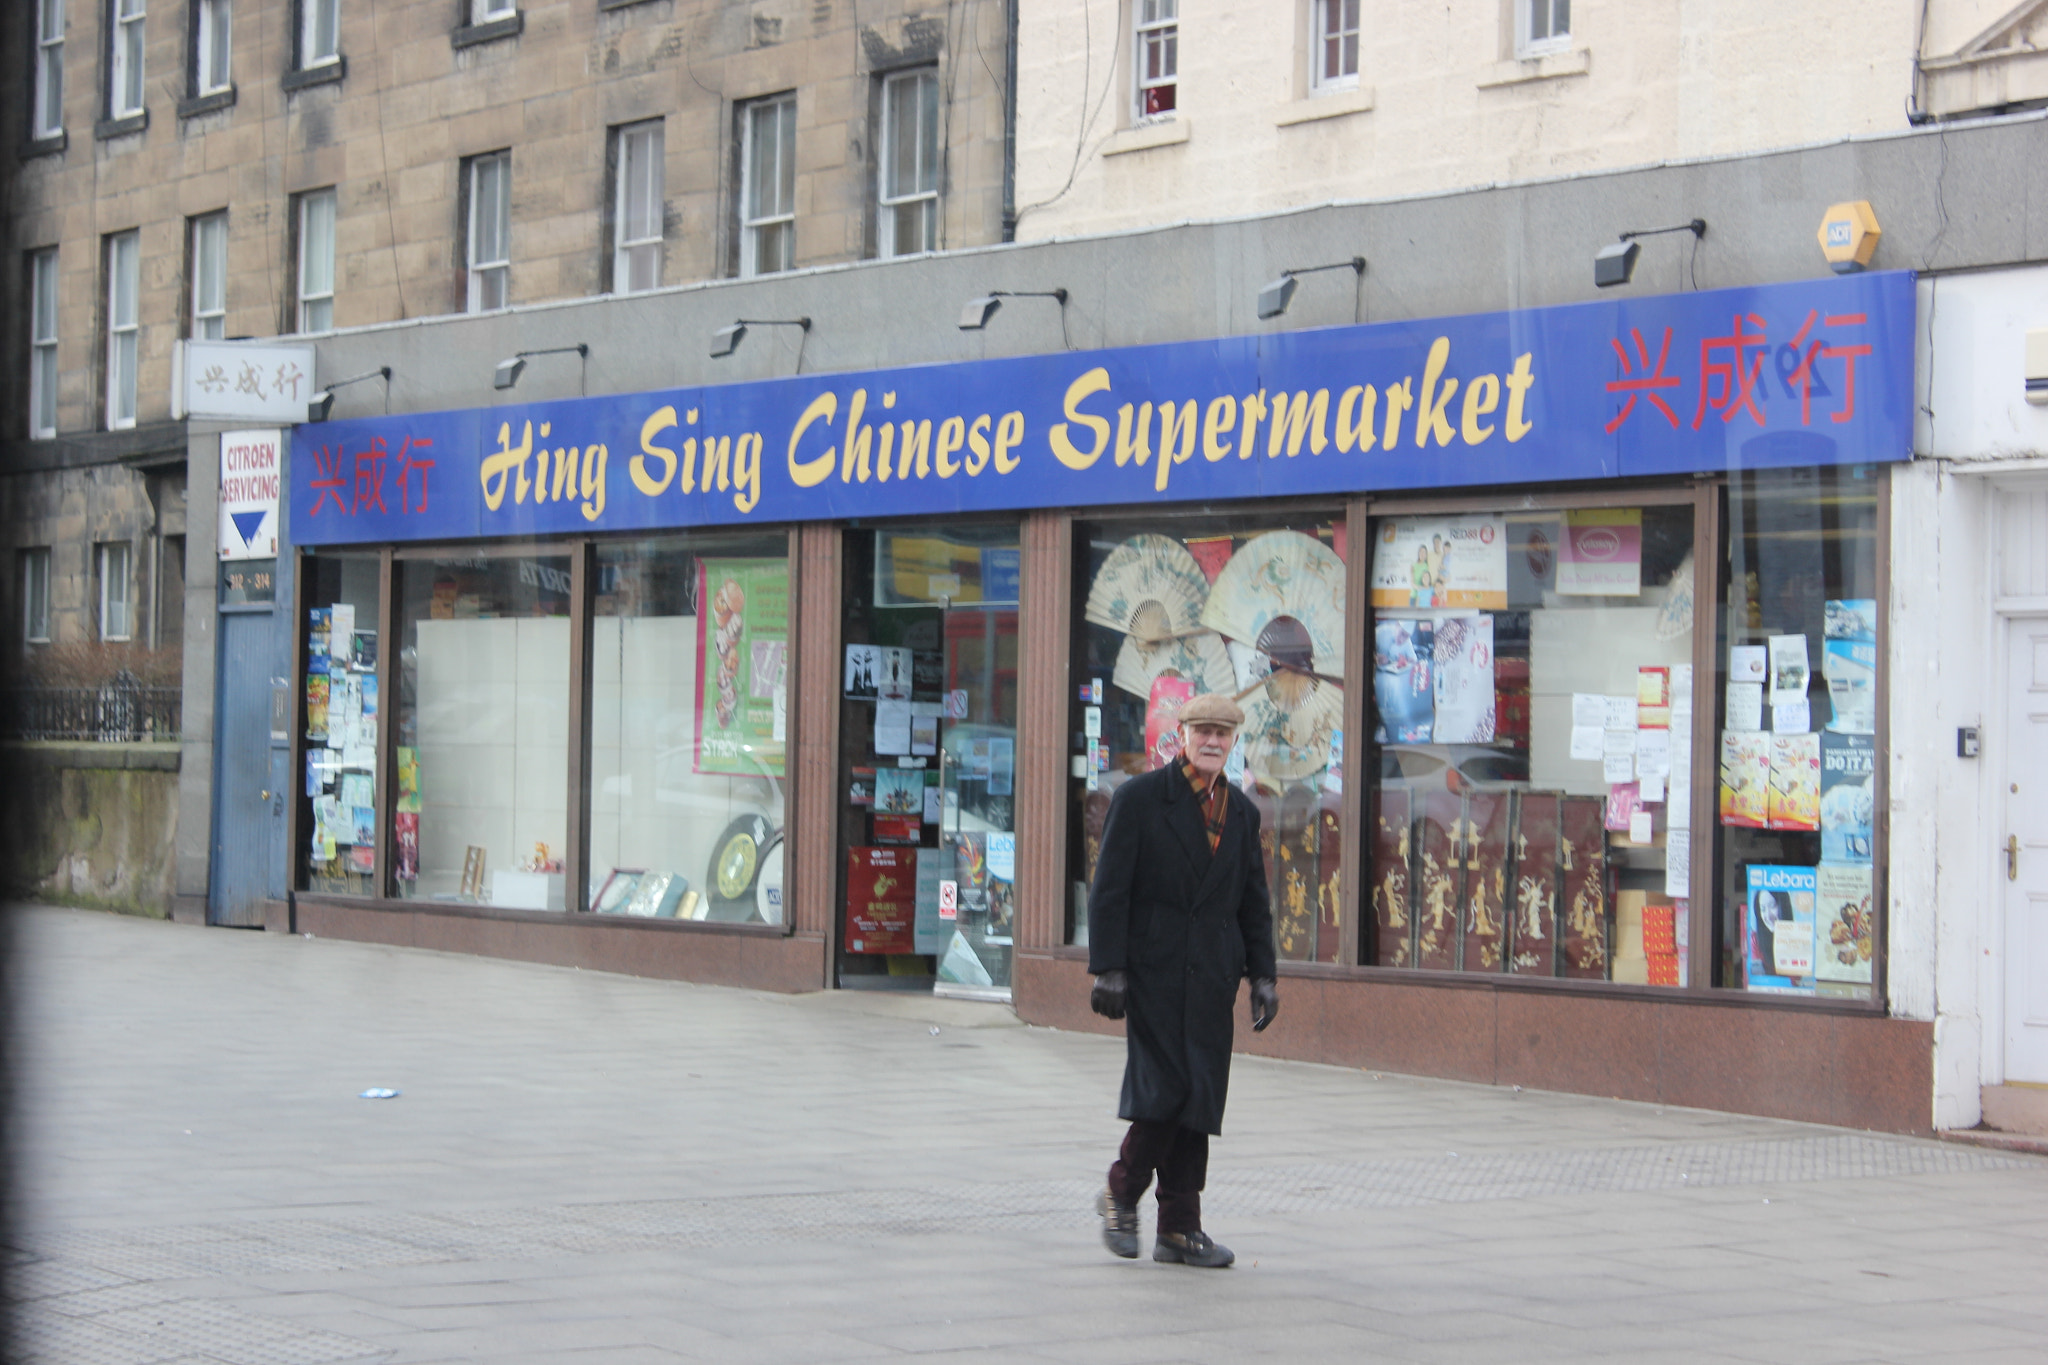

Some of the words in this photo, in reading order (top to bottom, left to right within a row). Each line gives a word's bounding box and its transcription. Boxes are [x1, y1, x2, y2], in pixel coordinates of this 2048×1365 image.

[1828, 221, 1852, 246] ADT
[1603, 308, 1873, 436] 兴成行
[480, 418, 608, 522] Hing
[629, 405, 763, 514] Sing
[788, 388, 1025, 488] Chinese
[1048, 336, 1535, 492] Supermarket
[227, 442, 275, 471] CITROEN
[223, 474, 279, 504] SERVICING
[309, 434, 436, 518] 兴成行
[254, 572, 271, 591] 314
[1825, 757, 1845, 770] DO
[1846, 757, 1862, 770] IT
[1763, 869, 1815, 889] Lebara
